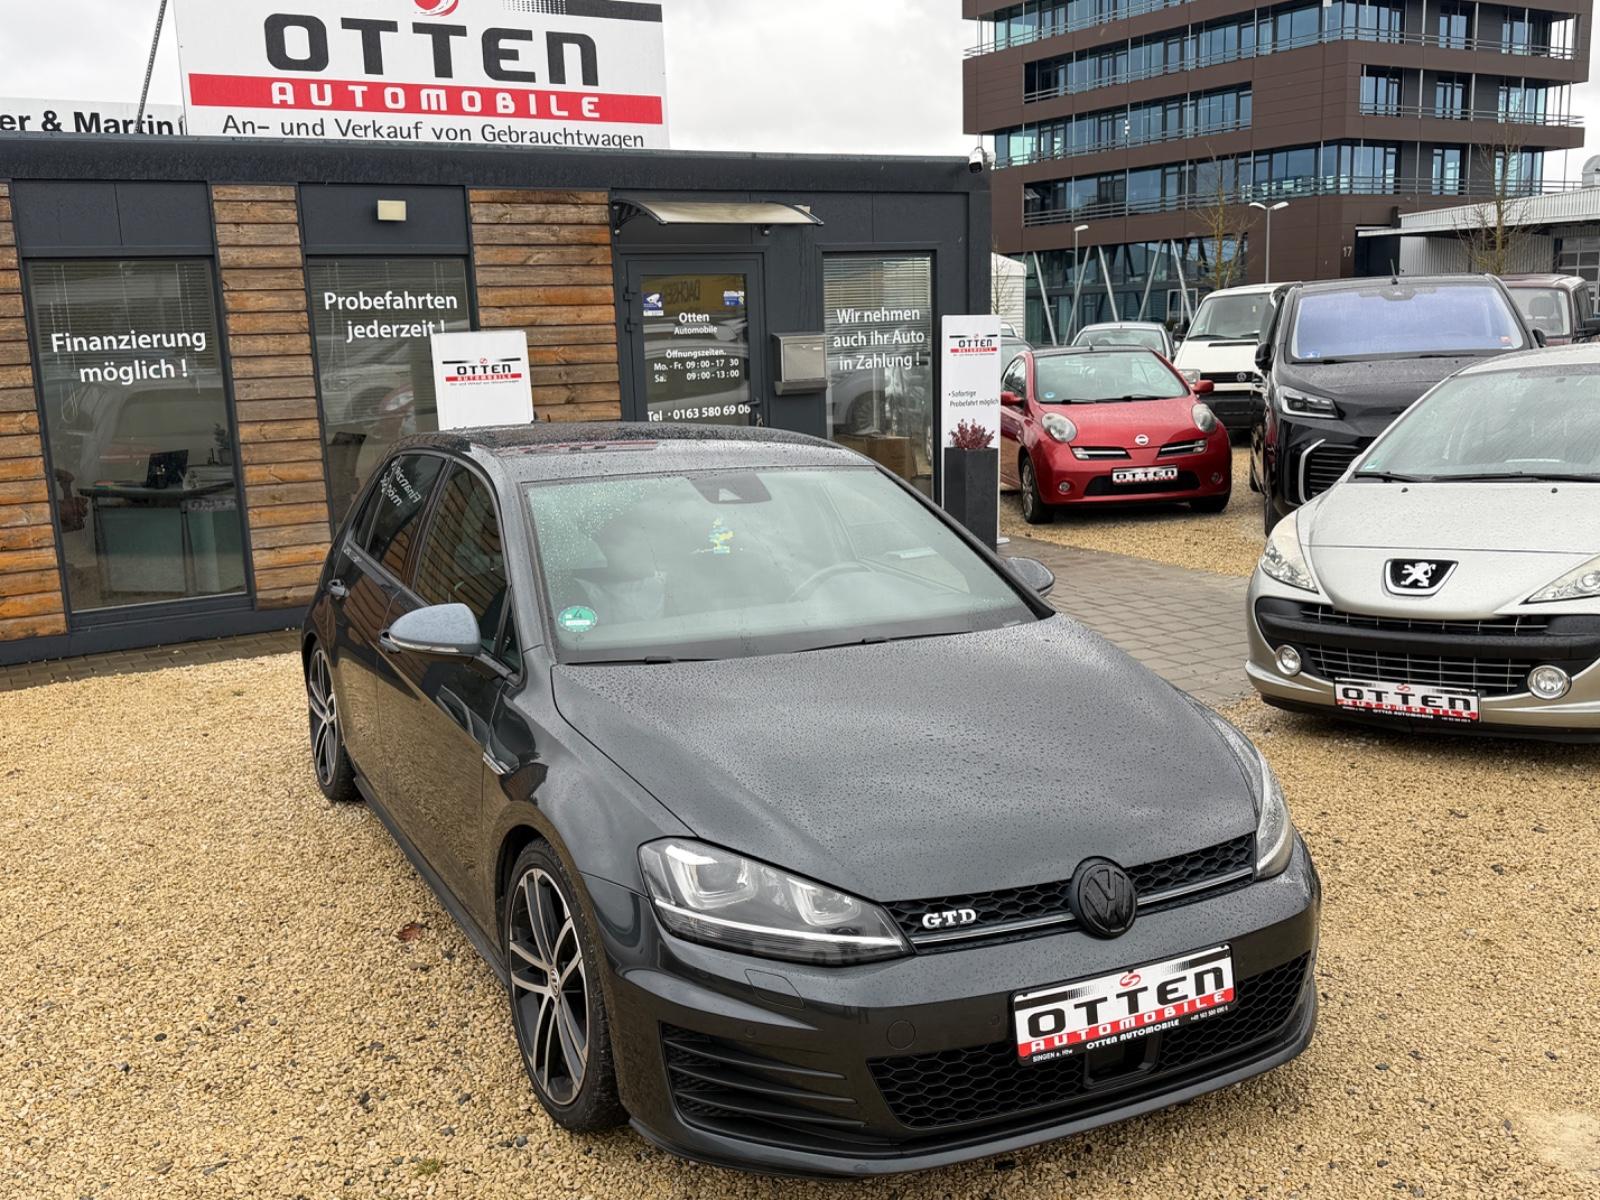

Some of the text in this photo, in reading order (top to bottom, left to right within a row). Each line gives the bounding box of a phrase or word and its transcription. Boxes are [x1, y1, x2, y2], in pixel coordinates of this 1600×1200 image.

[264, 13, 598, 86] OTTEN
[271, 81, 600, 118] AUTOMOBILE
[41, 110, 63, 132] &
[222, 115, 644, 148] An- und Verkauf von Gebrauchtwagen
[1342, 246, 1352, 257] 17
[324, 290, 458, 310] Probefahrten
[679, 312, 710, 323] Otten
[836, 307, 920, 324] Wir nehmen
[674, 325, 718, 335] Automobile
[833, 330, 925, 347] auch ihr Auto
[51, 329, 206, 353] Finanzierung
[958, 339, 993, 348] OTTEN
[79, 358, 176, 386] möglich
[456, 364, 511, 376] OTTEN
[839, 356, 853, 371] in
[855, 353, 913, 370] Zahlung
[672, 407, 699, 420] 0163
[701, 406, 721, 418] 580
[722, 404, 736, 416] 69
[1116, 469, 1175, 481] OTTEN
[1341, 687, 1472, 711] OTTEN
[922, 908, 977, 930] GTD
[1027, 966, 1224, 1039] OTTEN
[1030, 991, 1226, 1054] AUTOMOBILE
[1086, 1019, 1180, 1050] OTTEN AUTOMOBILE
